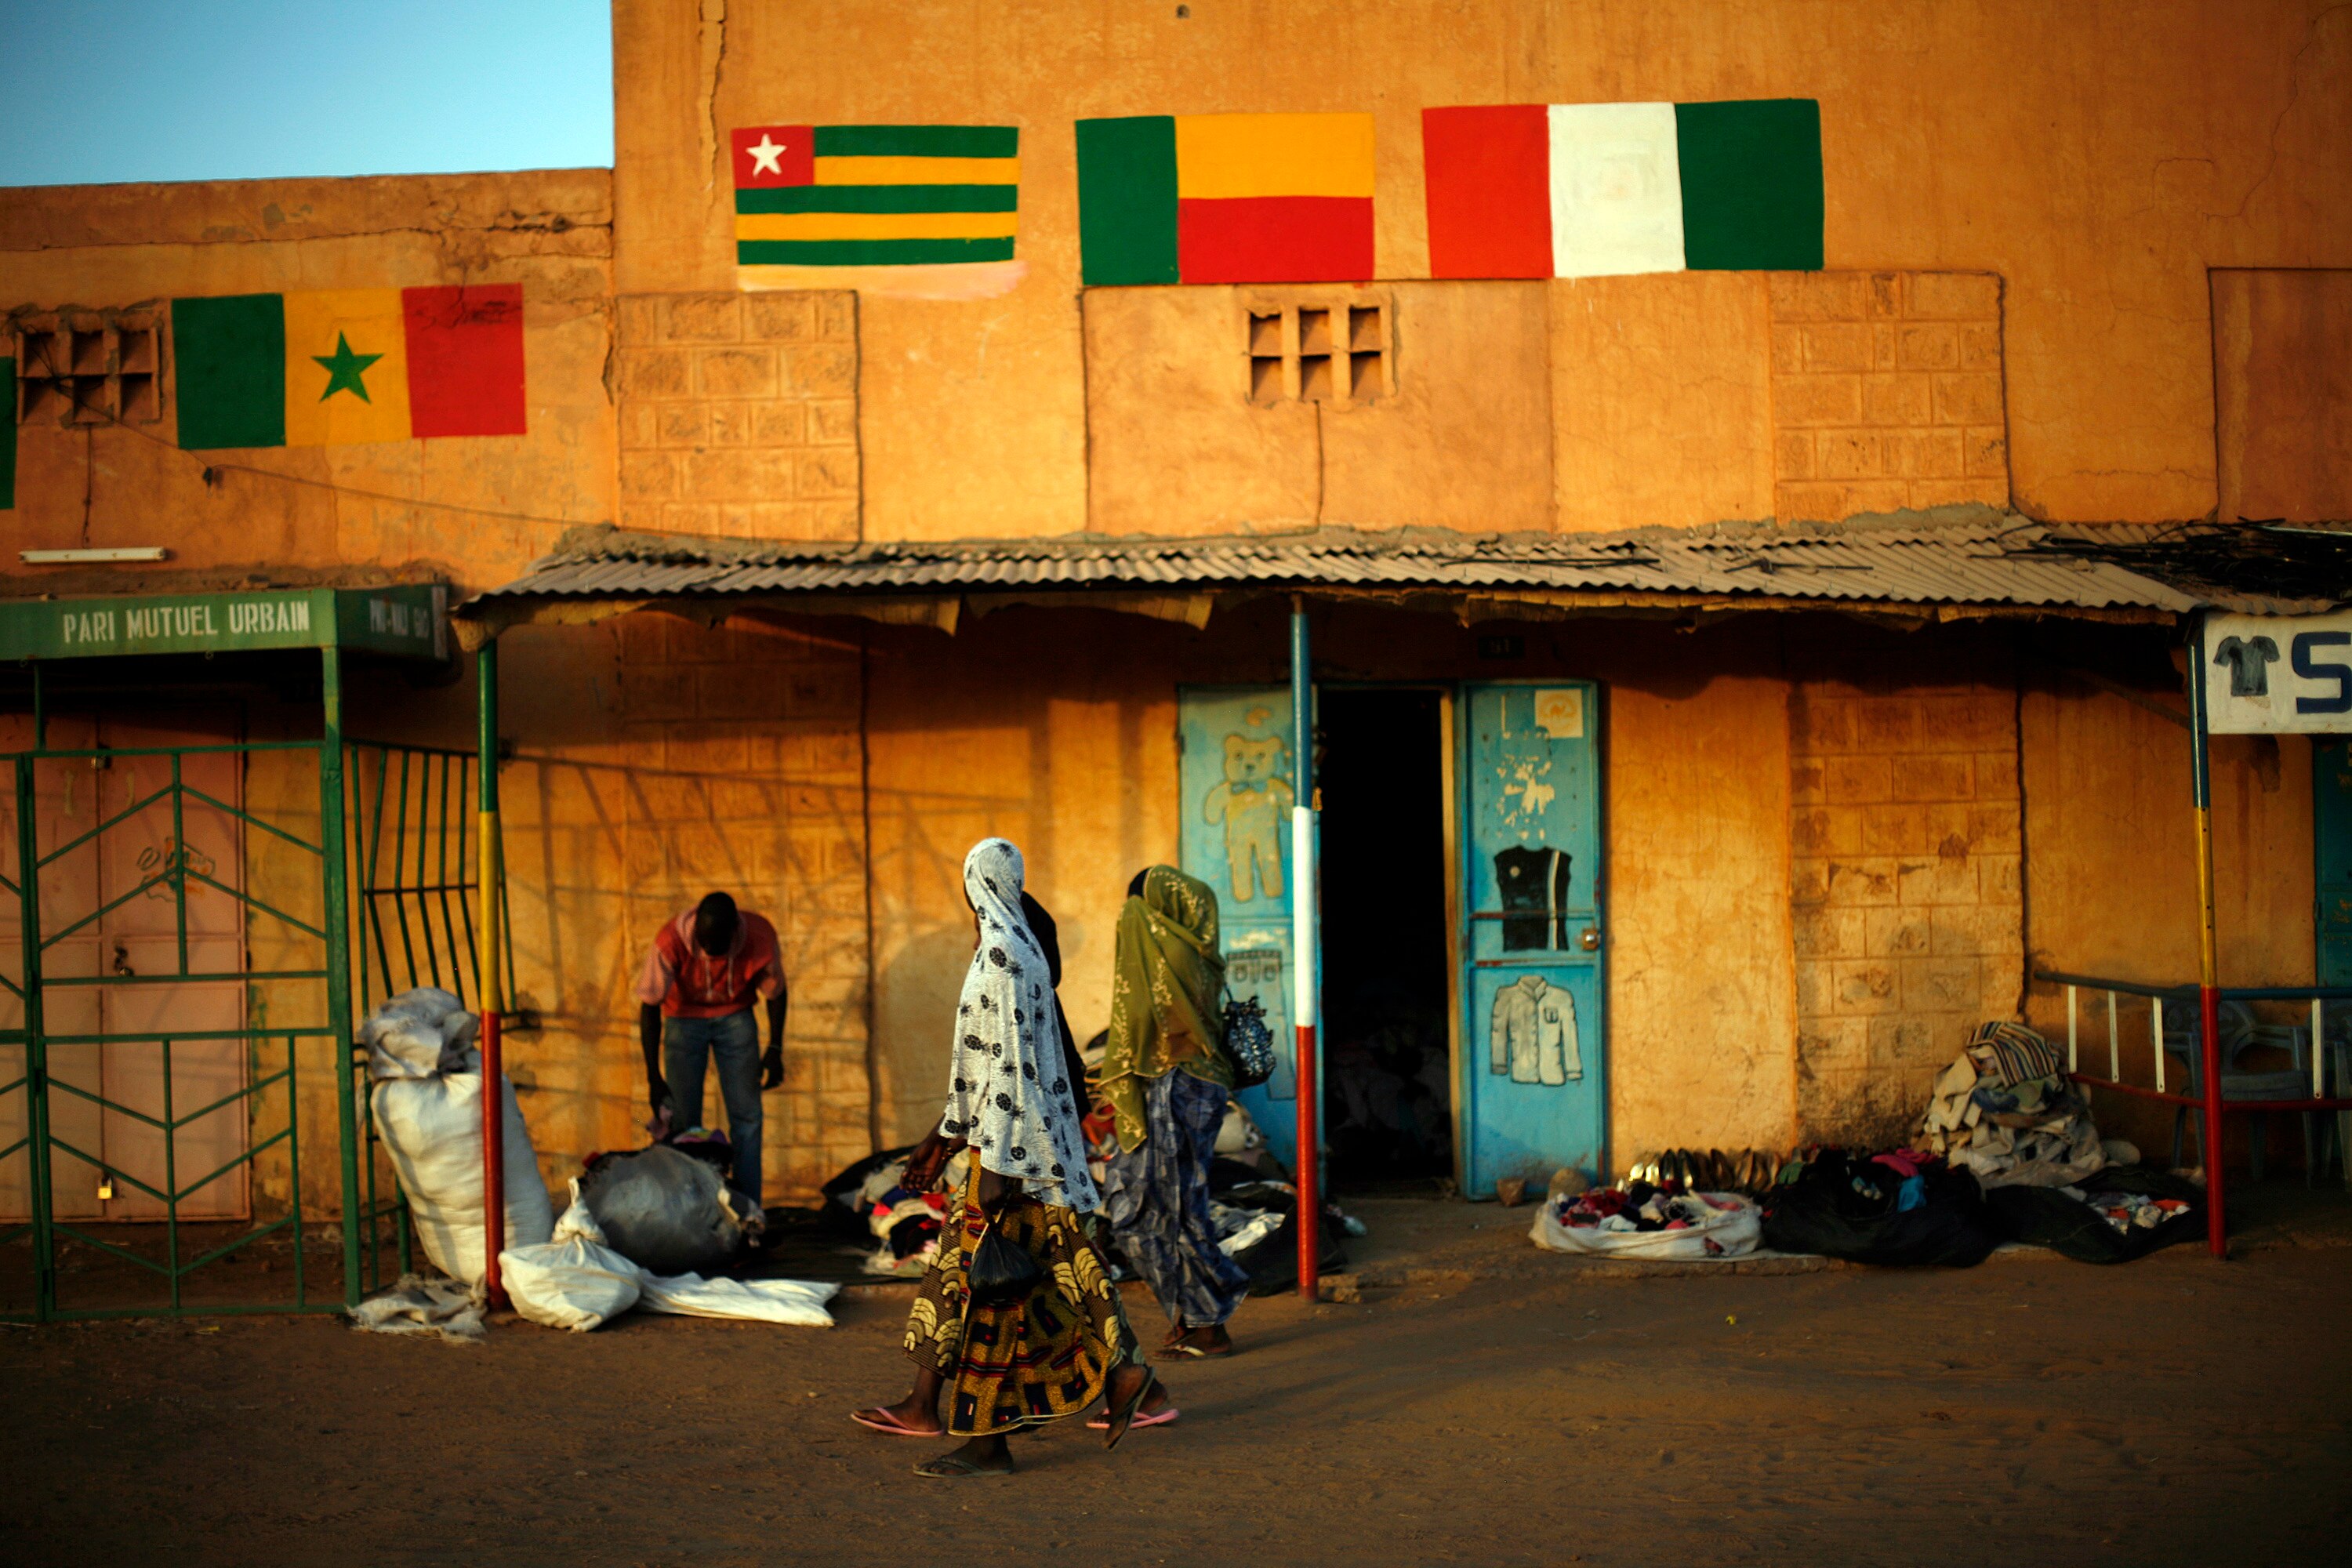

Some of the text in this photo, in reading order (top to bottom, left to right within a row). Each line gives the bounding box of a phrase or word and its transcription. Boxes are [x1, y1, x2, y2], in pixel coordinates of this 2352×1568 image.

[63, 601, 310, 644] PARI MUTUEL URBAIN
